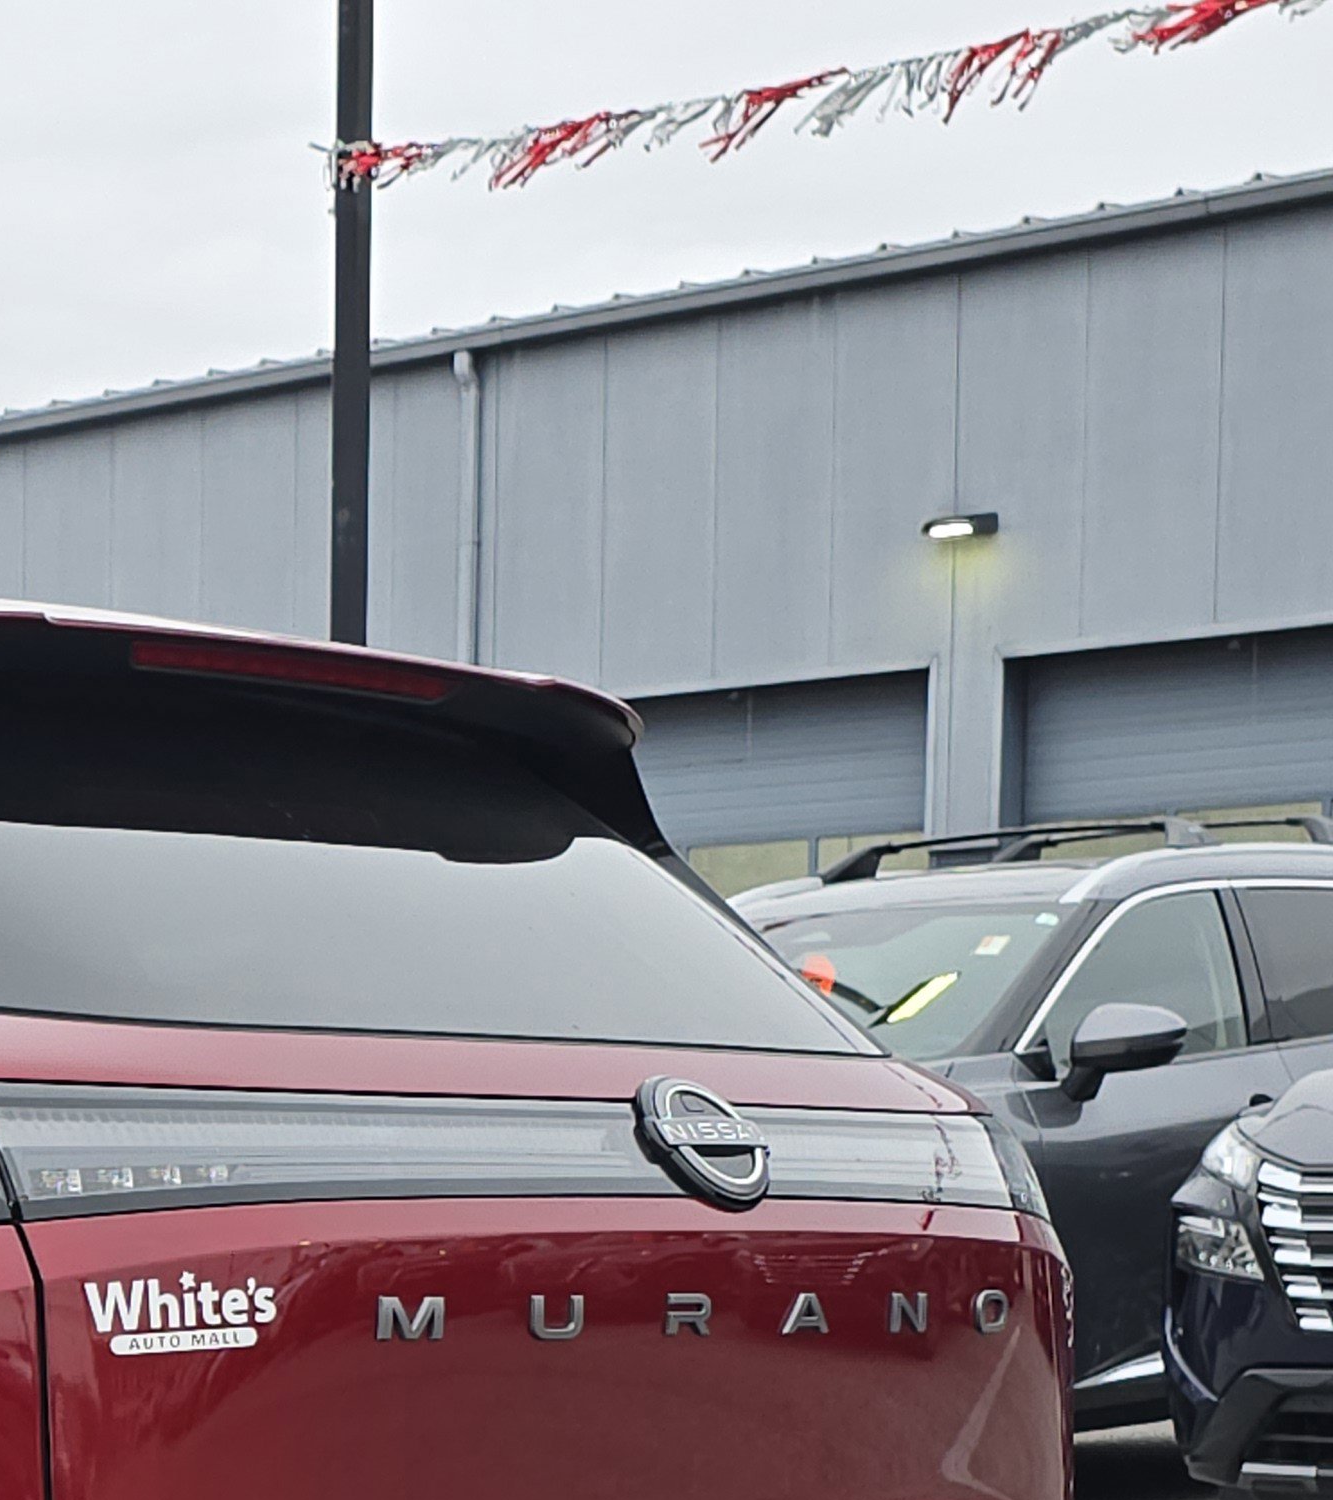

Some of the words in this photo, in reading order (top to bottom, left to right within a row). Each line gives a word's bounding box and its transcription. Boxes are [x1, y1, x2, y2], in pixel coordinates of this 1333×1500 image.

[661, 1121, 764, 1142] NISSA
[83, 1271, 278, 1333] White's
[376, 1288, 1011, 1341] MURANO
[129, 1335, 181, 1351] AUTO
[191, 1331, 240, 1347] MALL
